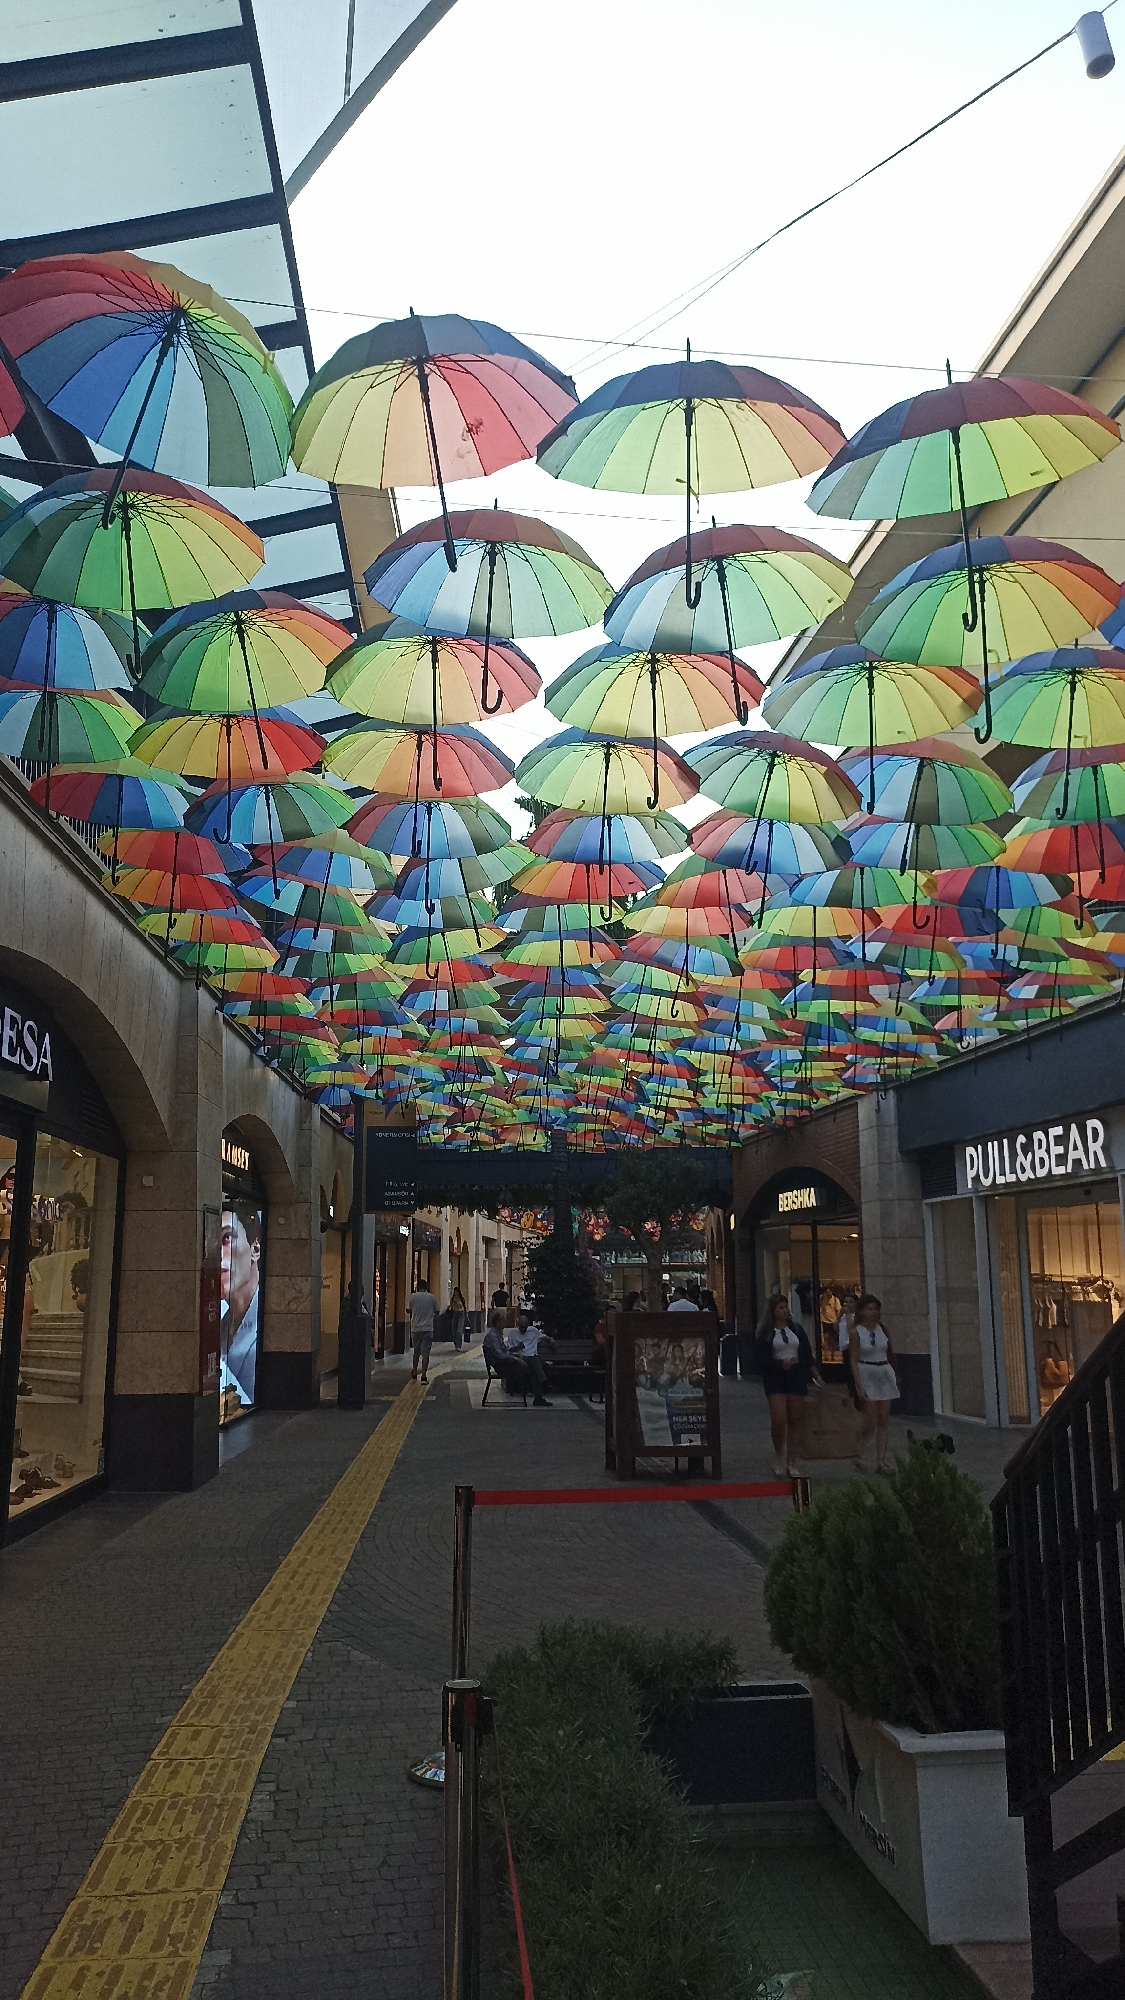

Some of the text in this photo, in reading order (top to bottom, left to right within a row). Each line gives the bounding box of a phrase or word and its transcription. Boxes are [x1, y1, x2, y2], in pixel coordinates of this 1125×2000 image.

[0, 1006, 53, 1081] ESA
[222, 1138, 250, 1170] RAMSEY
[966, 1119, 1106, 1188] PULL&BEAR
[779, 1187, 817, 1213] BERSHKA
